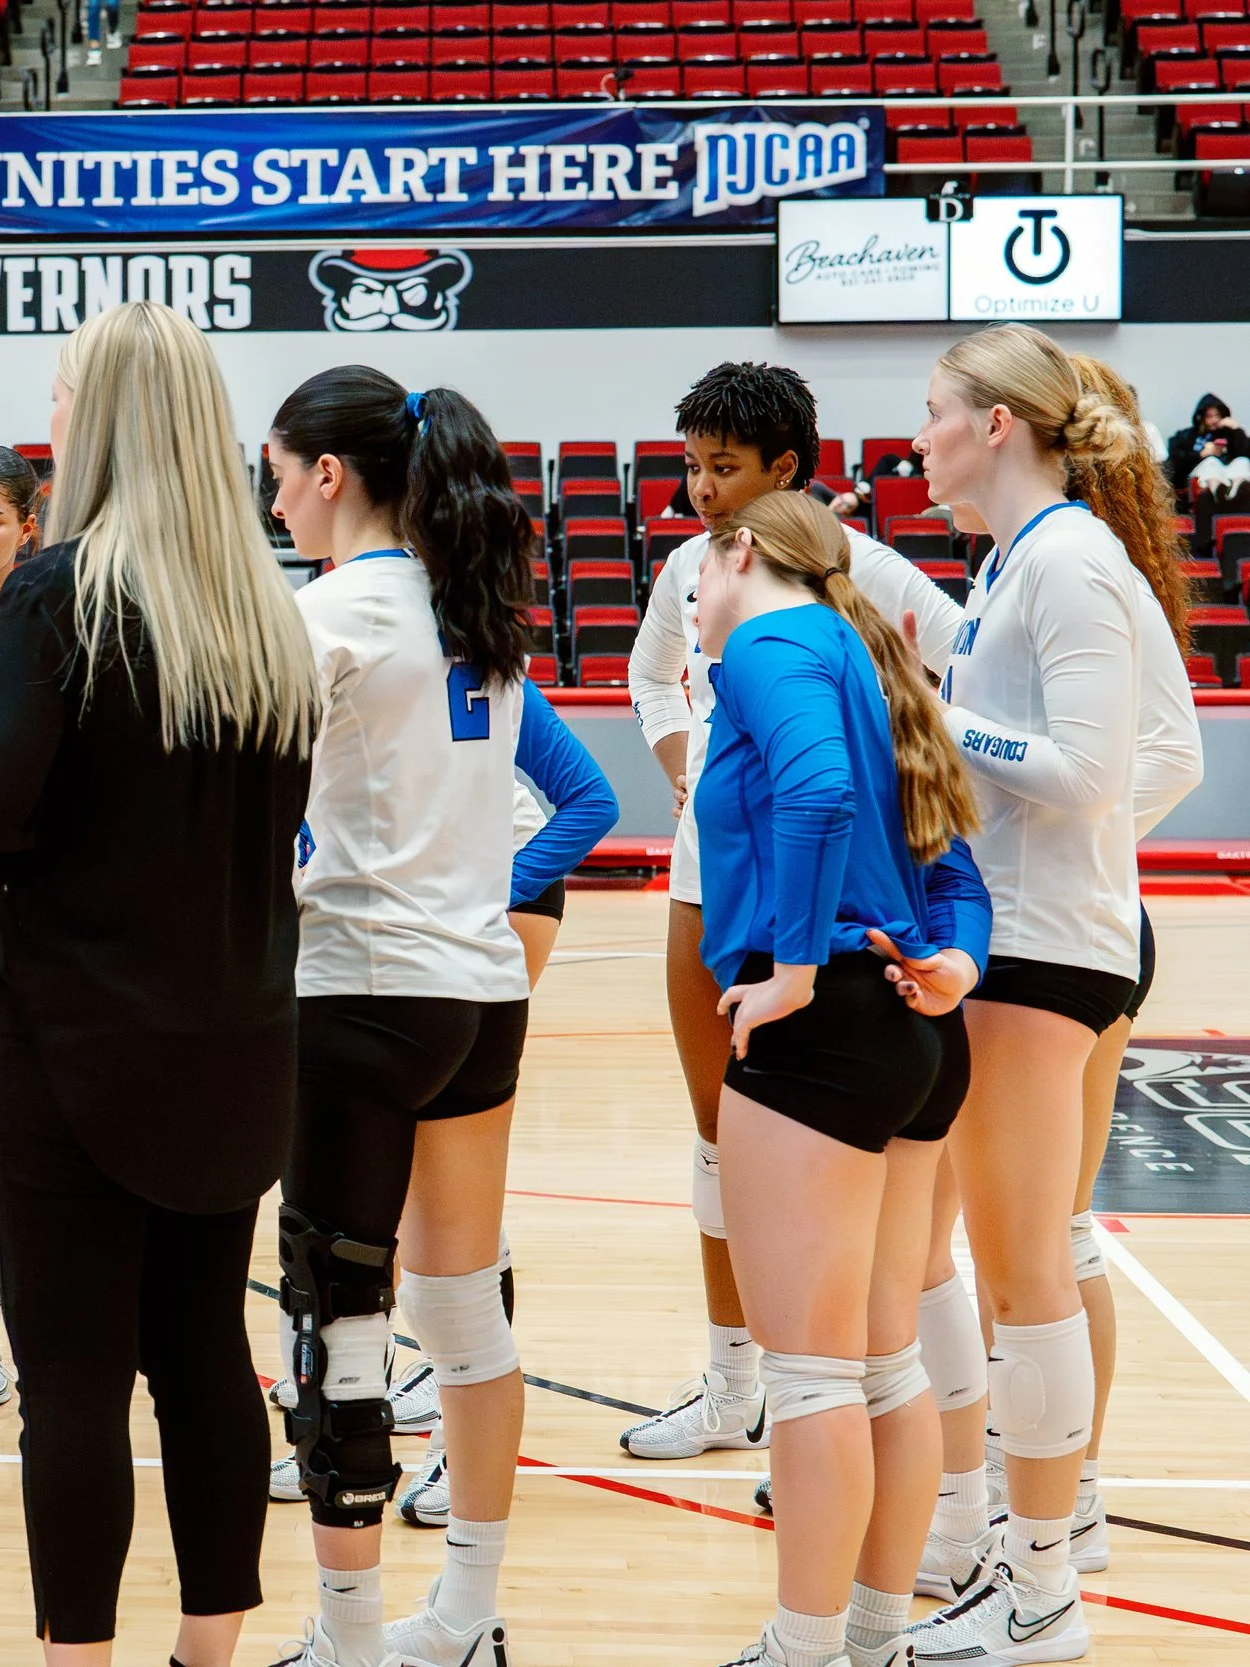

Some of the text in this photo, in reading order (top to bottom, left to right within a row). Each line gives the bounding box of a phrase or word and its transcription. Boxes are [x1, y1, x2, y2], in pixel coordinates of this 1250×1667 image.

[251, 147, 478, 204] START
[487, 143, 679, 201] HERE
[699, 127, 862, 209] NJCAA
[974, 294, 1100, 316] Optimize U
[963, 729, 1028, 762] COUGARS
